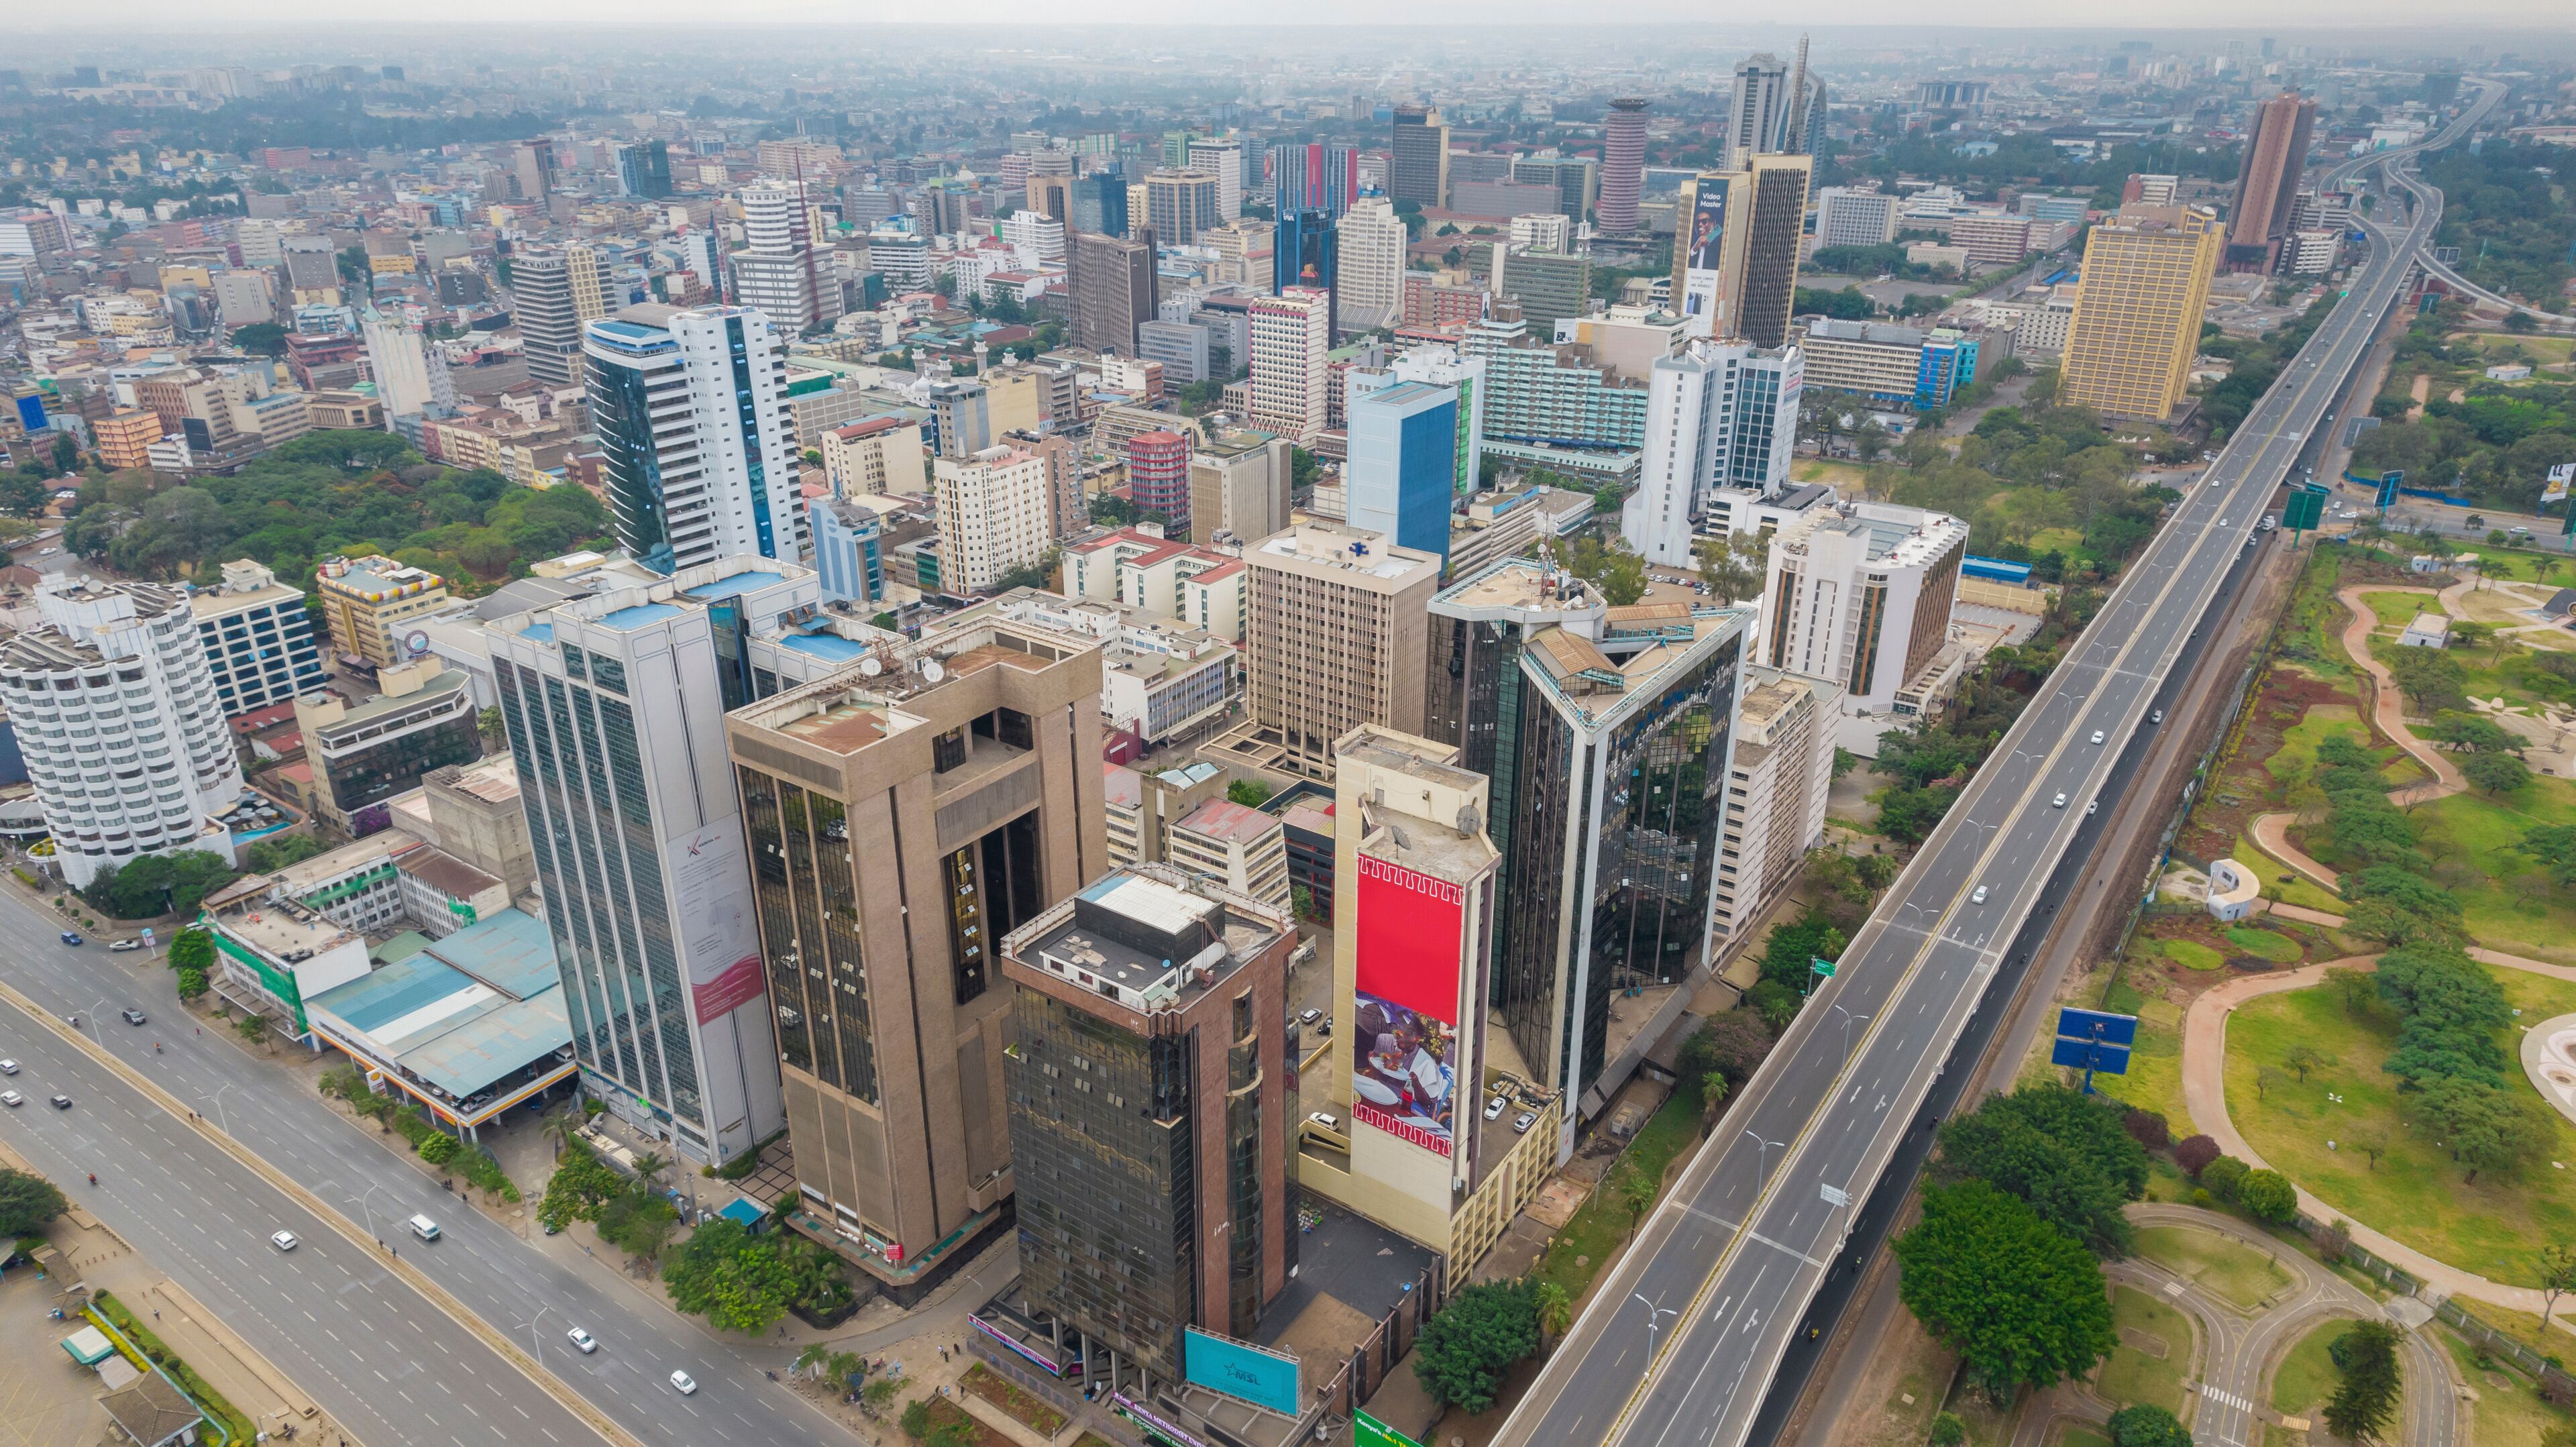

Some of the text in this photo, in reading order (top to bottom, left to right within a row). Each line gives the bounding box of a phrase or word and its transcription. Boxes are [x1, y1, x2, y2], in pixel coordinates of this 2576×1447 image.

[698, 839, 714, 848] KENYA
[1235, 1371, 1261, 1386] MSL
[1134, 1403, 1153, 1420] KENYA
[1153, 1415, 1188, 1440] METHODIST
[1134, 1417, 1171, 1442] CO-OPERATIVE
[1357, 1417, 1382, 1436] Kenya's
[1382, 1432, 1397, 1444] No.1
